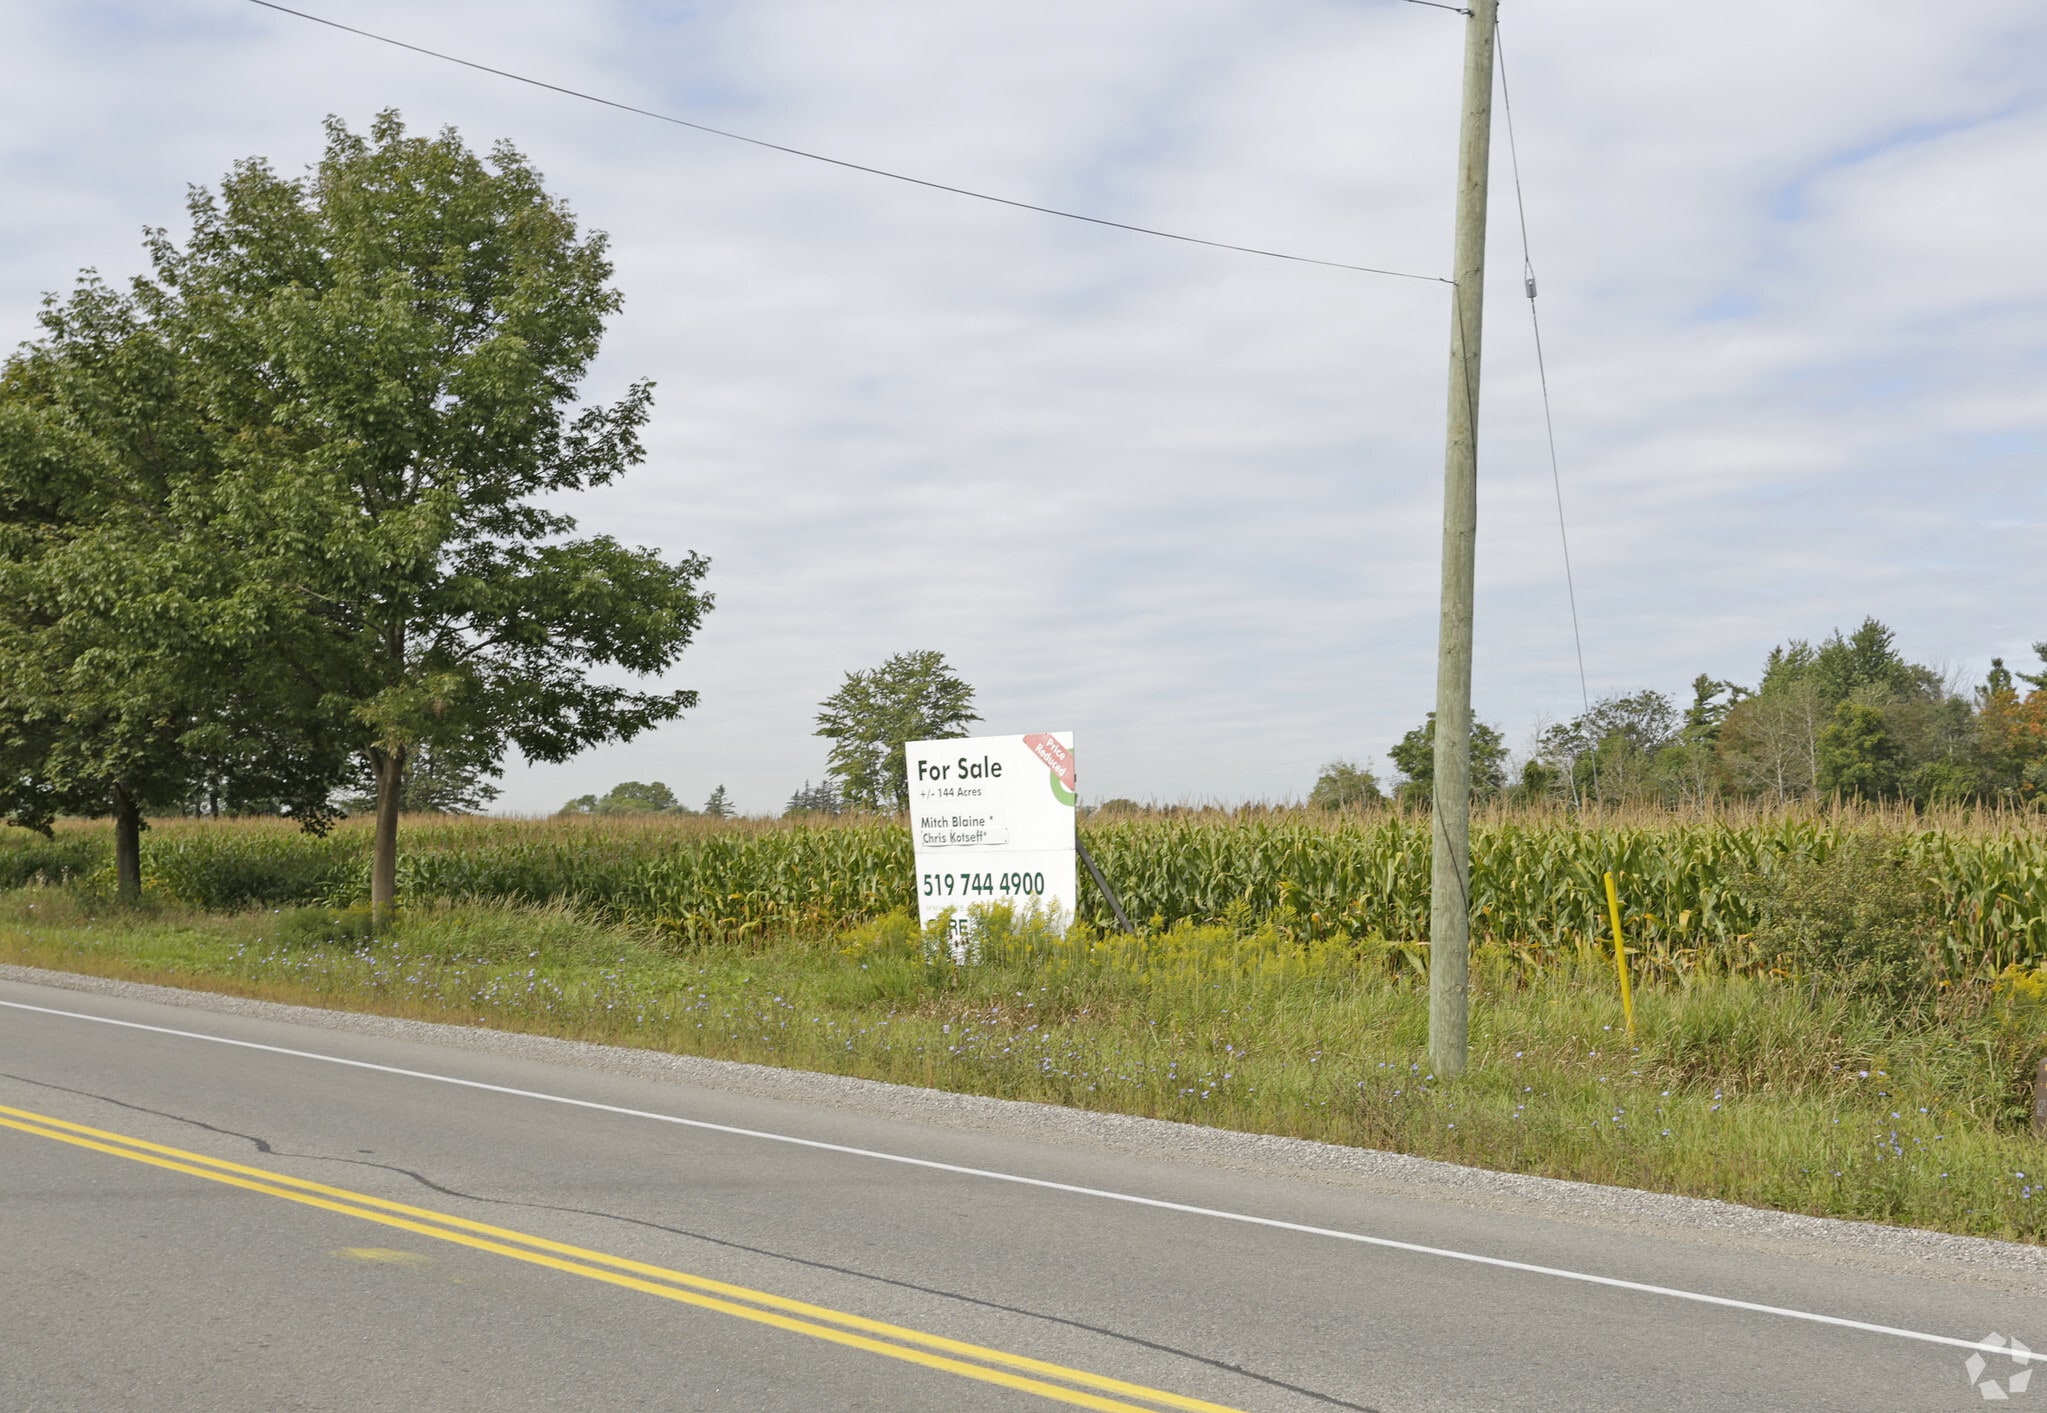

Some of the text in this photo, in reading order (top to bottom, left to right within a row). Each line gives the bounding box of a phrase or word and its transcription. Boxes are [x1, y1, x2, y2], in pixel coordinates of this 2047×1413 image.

[1035, 743, 1067, 776] Reduced
[1046, 738, 1066, 760] Price
[918, 755, 1002, 781] For Sale
[938, 787, 954, 798] 144
[957, 787, 982, 797] Acres
[921, 815, 985, 828] Mitch Blaine
[923, 833, 946, 843] Chris
[924, 872, 1044, 896] 519 744 4900
